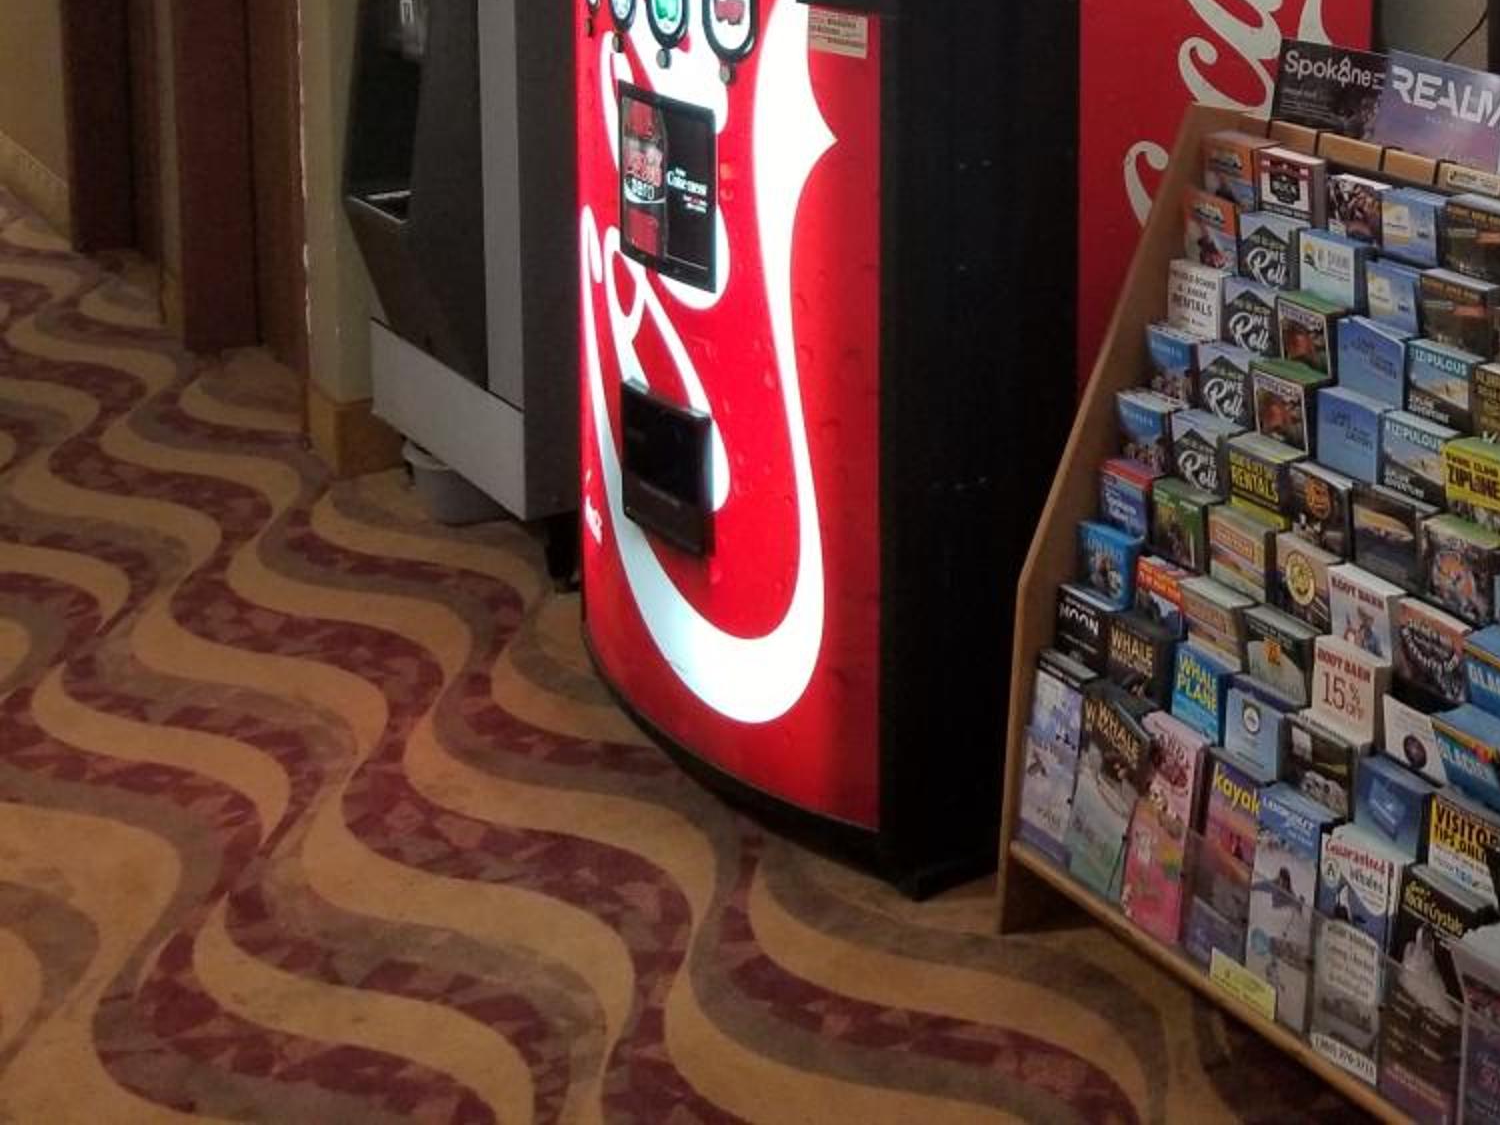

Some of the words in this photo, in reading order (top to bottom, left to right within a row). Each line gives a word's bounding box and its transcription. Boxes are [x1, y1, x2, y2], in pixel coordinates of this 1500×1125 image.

[1284, 47, 1372, 89] Spokane
[1231, 464, 1280, 504] RENTALS
[1447, 462, 1500, 500] ZIPLINE
[1111, 625, 1153, 660] WHALE
[1178, 653, 1217, 688] WHALE
[1316, 647, 1344, 669] BOOT
[1344, 661, 1372, 684] BARN
[1177, 671, 1217, 713] PLANE
[1321, 672, 1346, 712] 15
[1213, 761, 1261, 817] kayak
